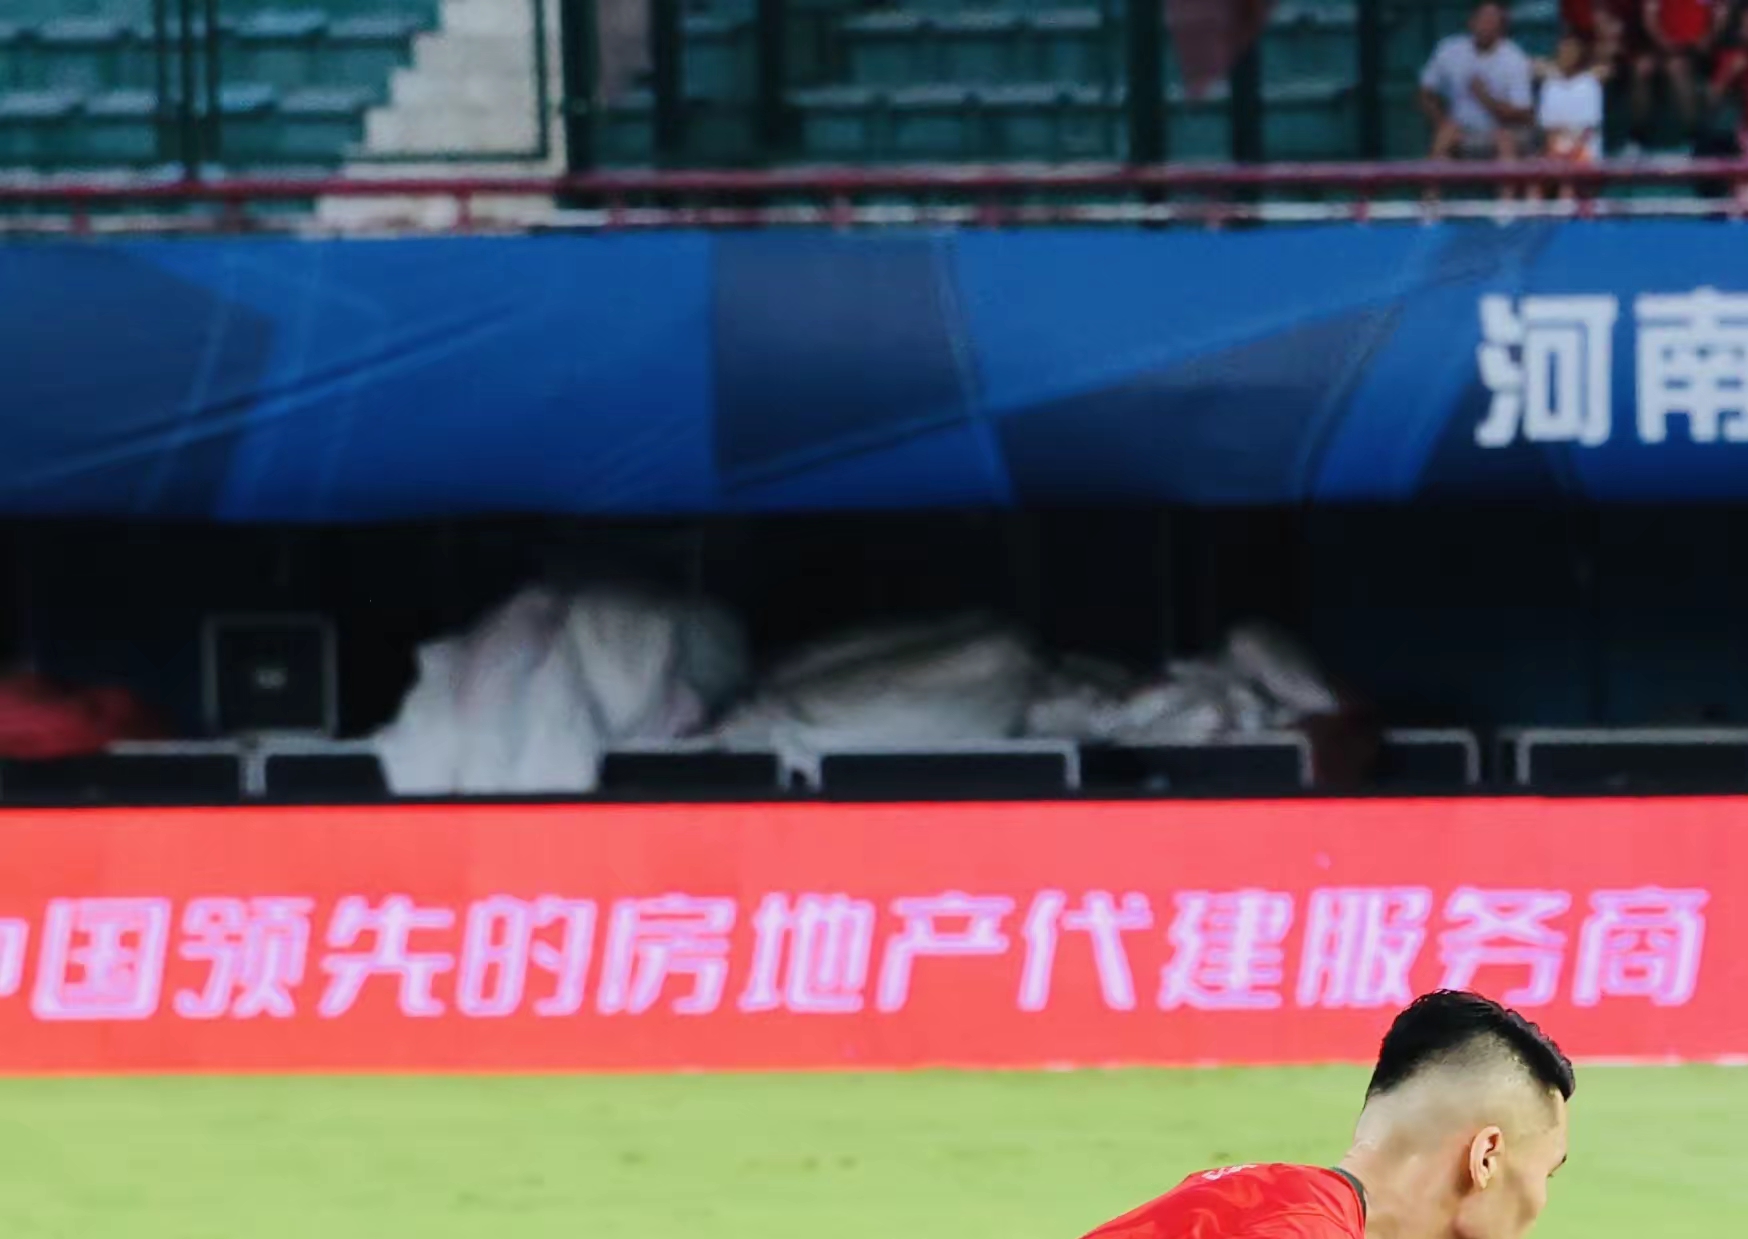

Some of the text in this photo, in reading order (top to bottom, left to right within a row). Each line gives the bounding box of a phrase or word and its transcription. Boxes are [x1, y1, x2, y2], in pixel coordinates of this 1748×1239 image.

[0, 885, 1711, 1020] 国领先的房地产代建服务商
